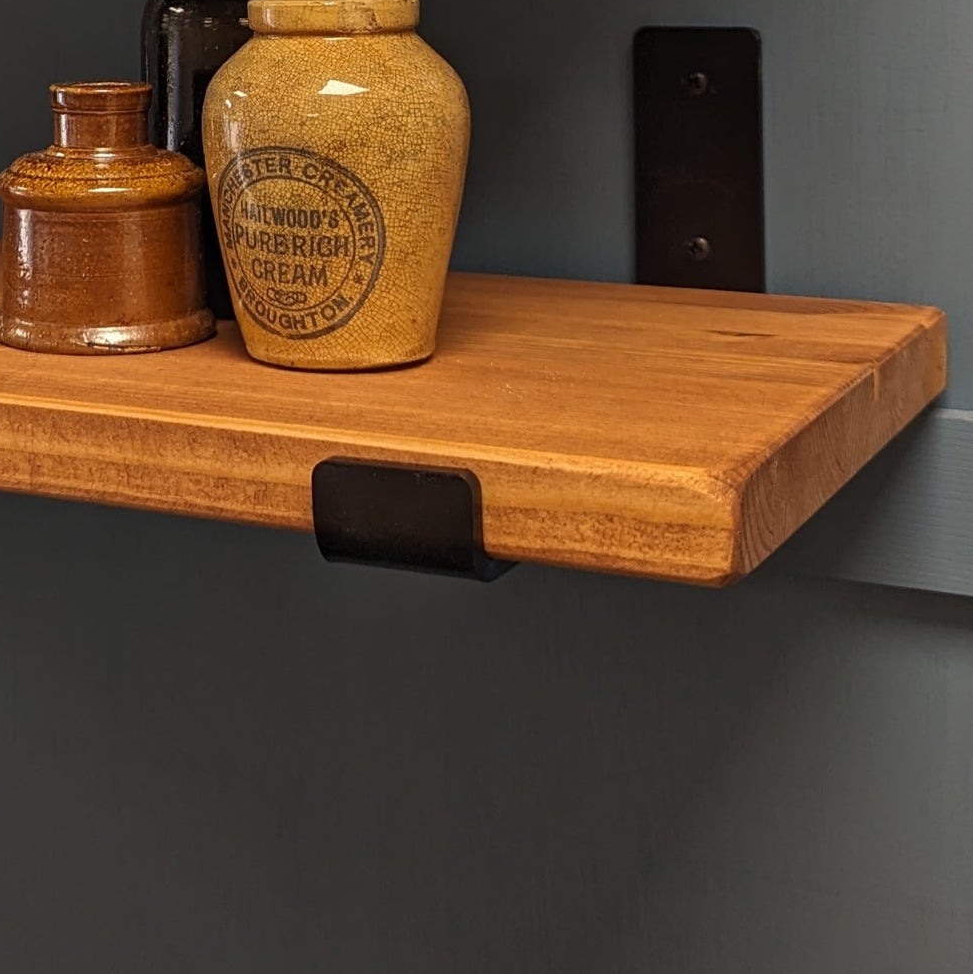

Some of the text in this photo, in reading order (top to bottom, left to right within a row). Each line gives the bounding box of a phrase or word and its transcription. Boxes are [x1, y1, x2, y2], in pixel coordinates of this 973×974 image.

[220, 158, 376, 266] MANCHESTER CREAMERY
[251, 258, 329, 286] CREAM
